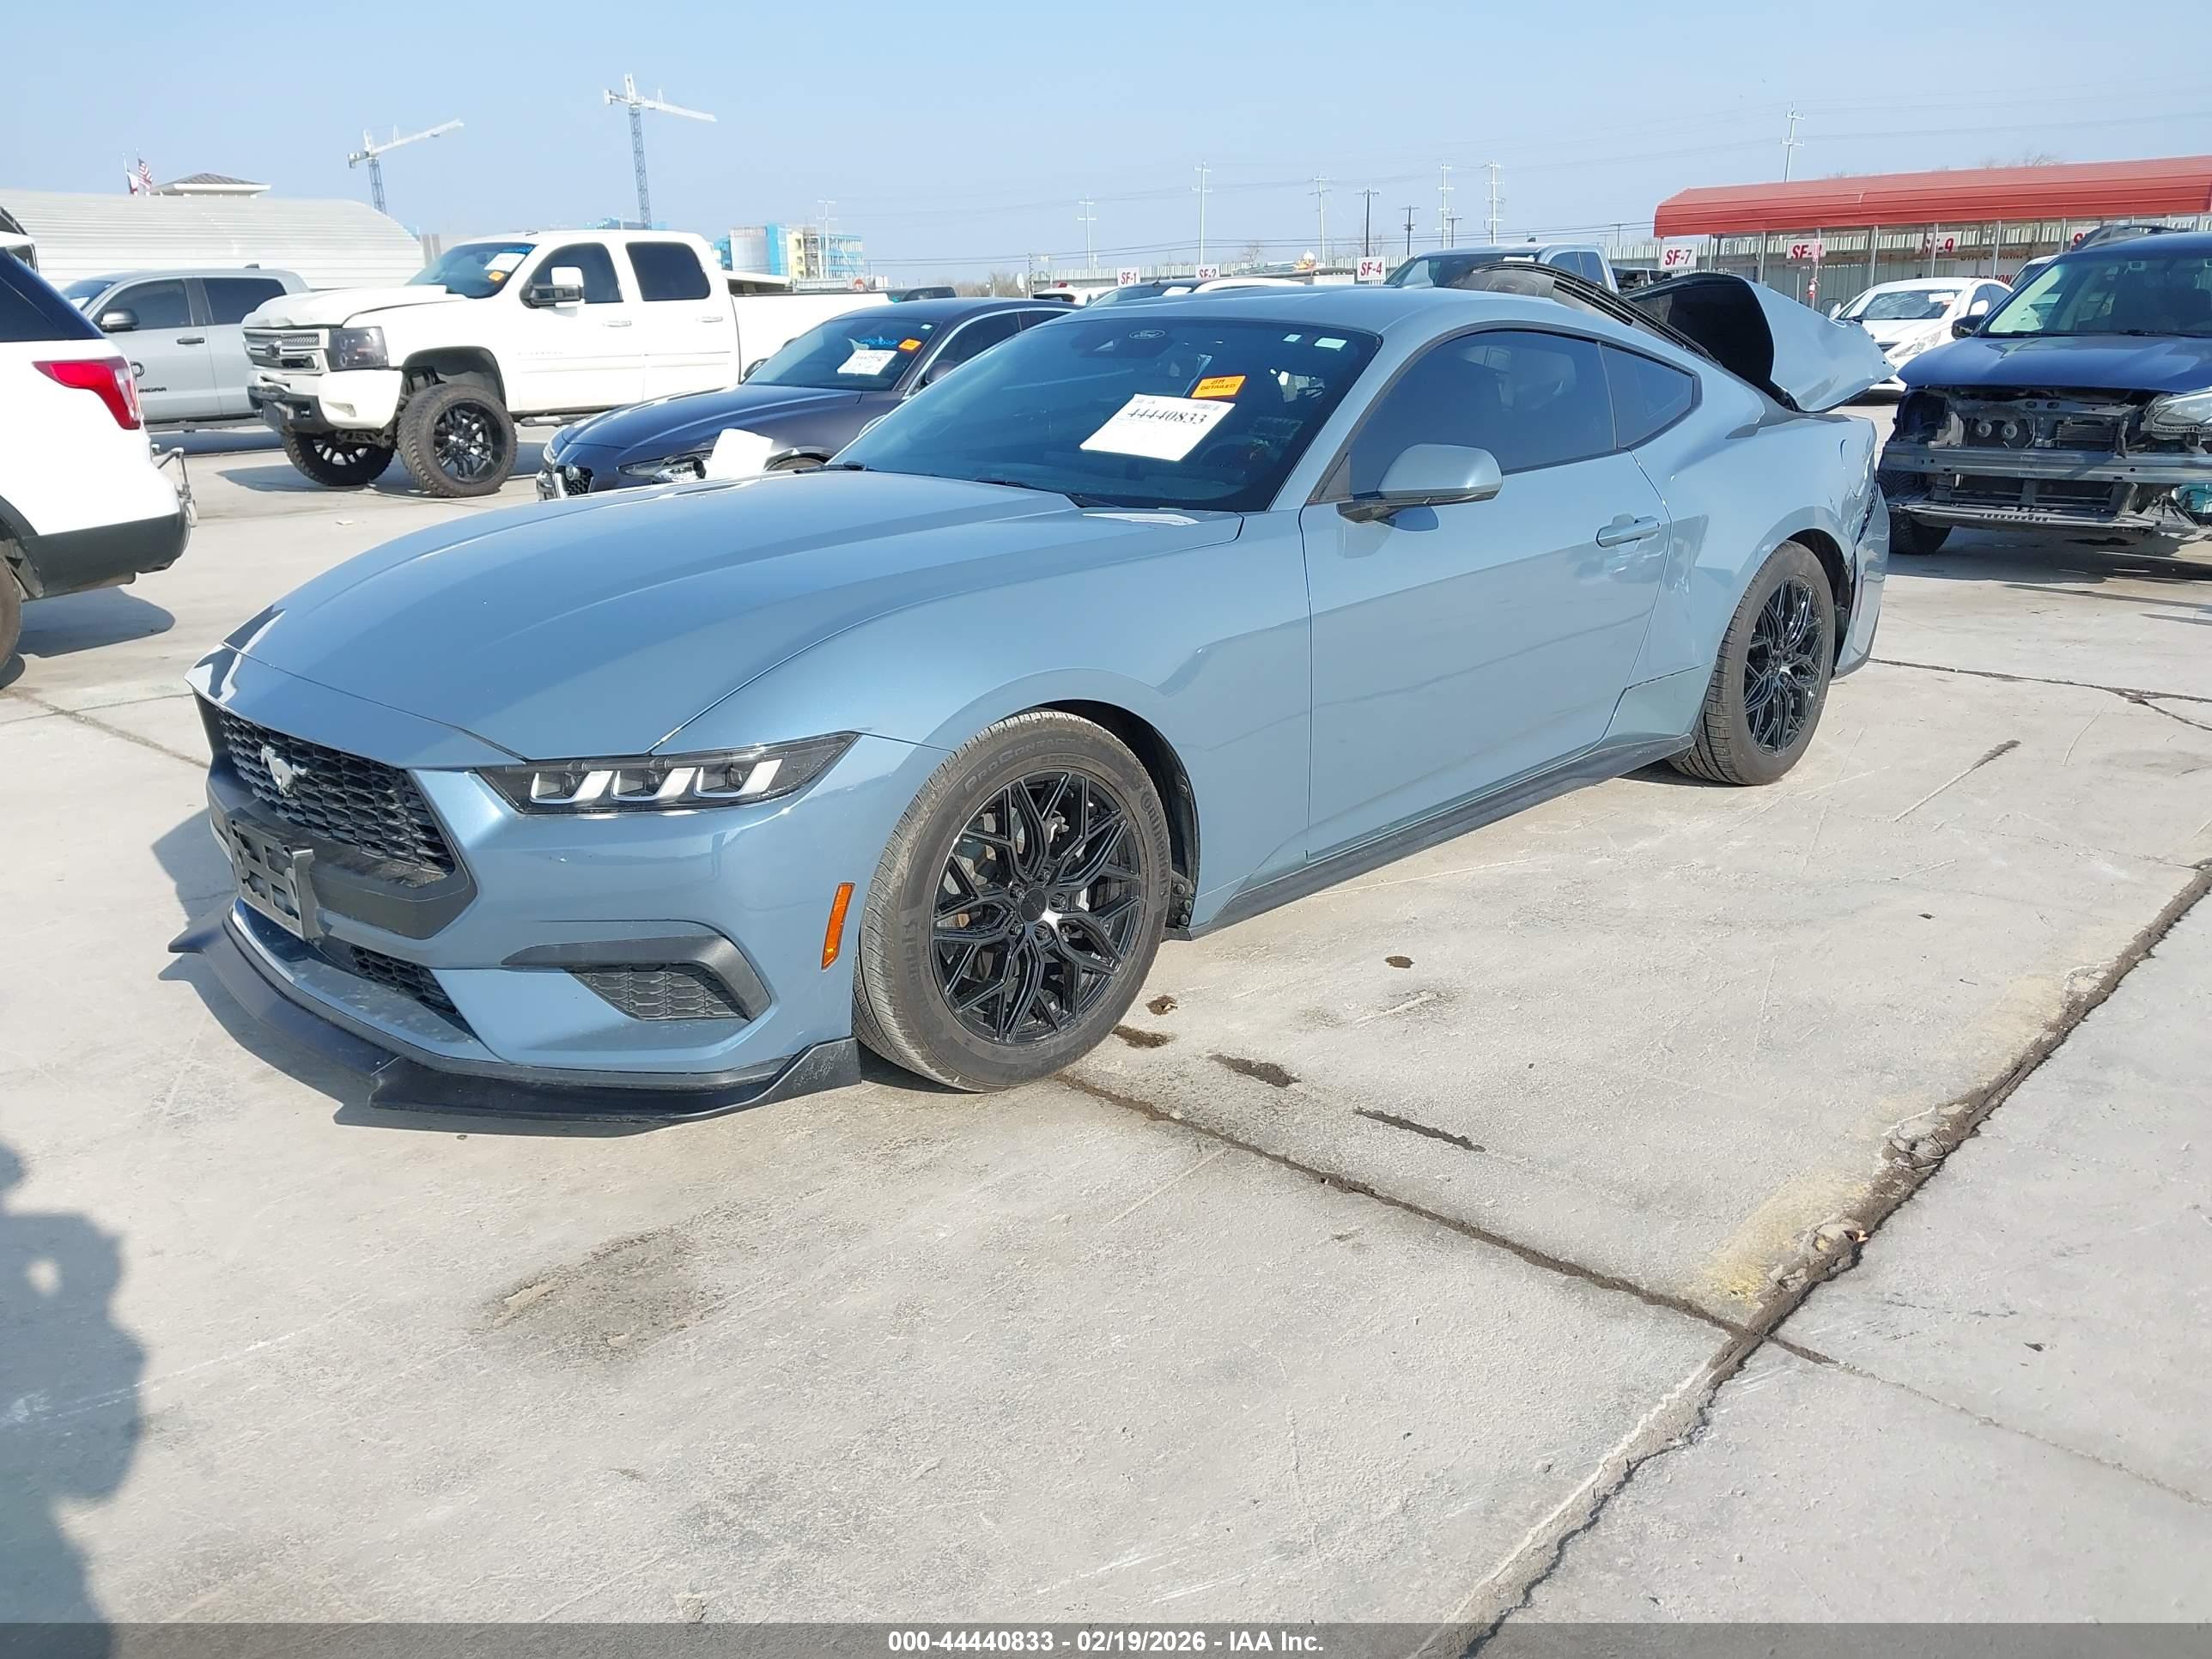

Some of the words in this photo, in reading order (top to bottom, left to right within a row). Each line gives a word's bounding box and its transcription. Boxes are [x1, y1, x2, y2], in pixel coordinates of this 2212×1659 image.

[1664, 249, 1692, 265] SF-7
[1360, 261, 1382, 276] SF-4
[1121, 272, 1137, 285] SF-1
[1127, 408, 1207, 425] 44440833
